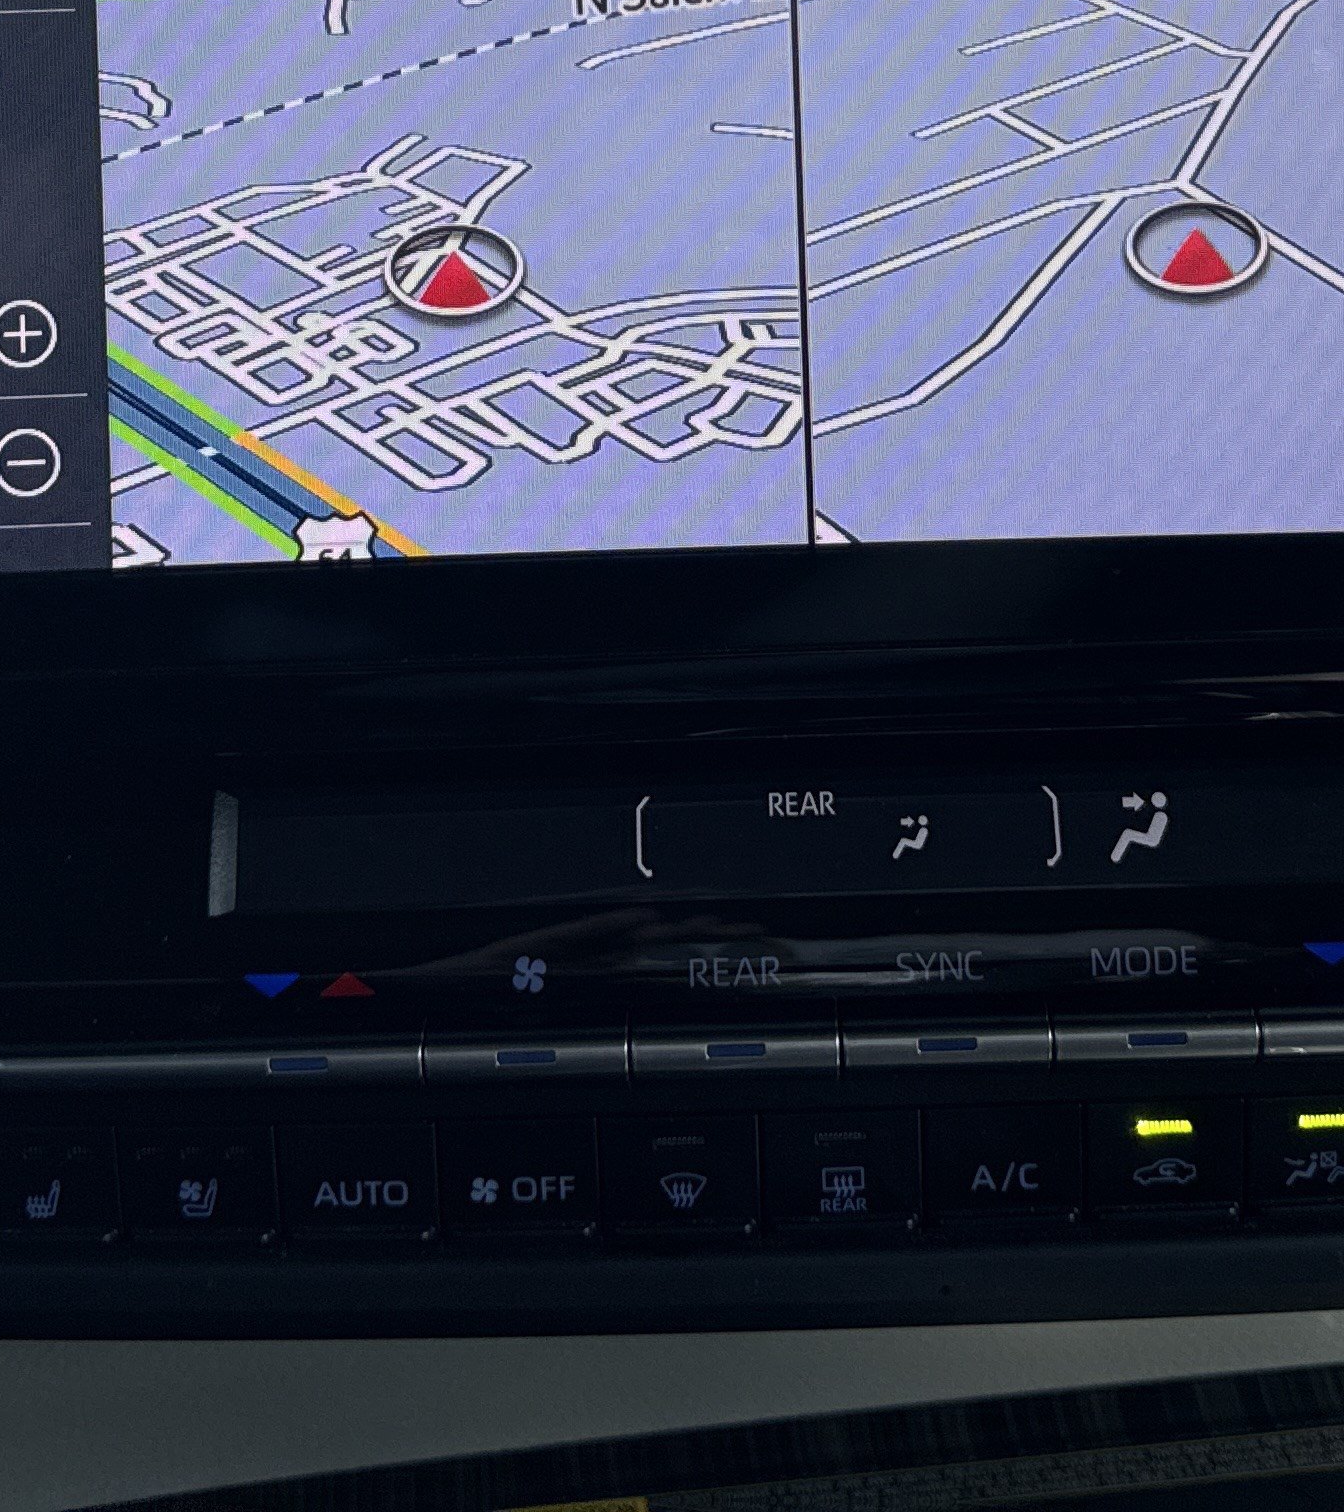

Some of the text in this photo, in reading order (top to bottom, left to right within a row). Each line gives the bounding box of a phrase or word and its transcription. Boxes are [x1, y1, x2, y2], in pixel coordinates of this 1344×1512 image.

[768, 791, 835, 817] REAR
[689, 956, 781, 988] REAR
[896, 951, 984, 981] SYNC
[1090, 946, 1198, 976] MODE
[512, 1175, 575, 1202] OFF
[971, 1161, 1039, 1191] A/C
[314, 1180, 409, 1208] AUTO
[820, 1196, 867, 1213] REAR
